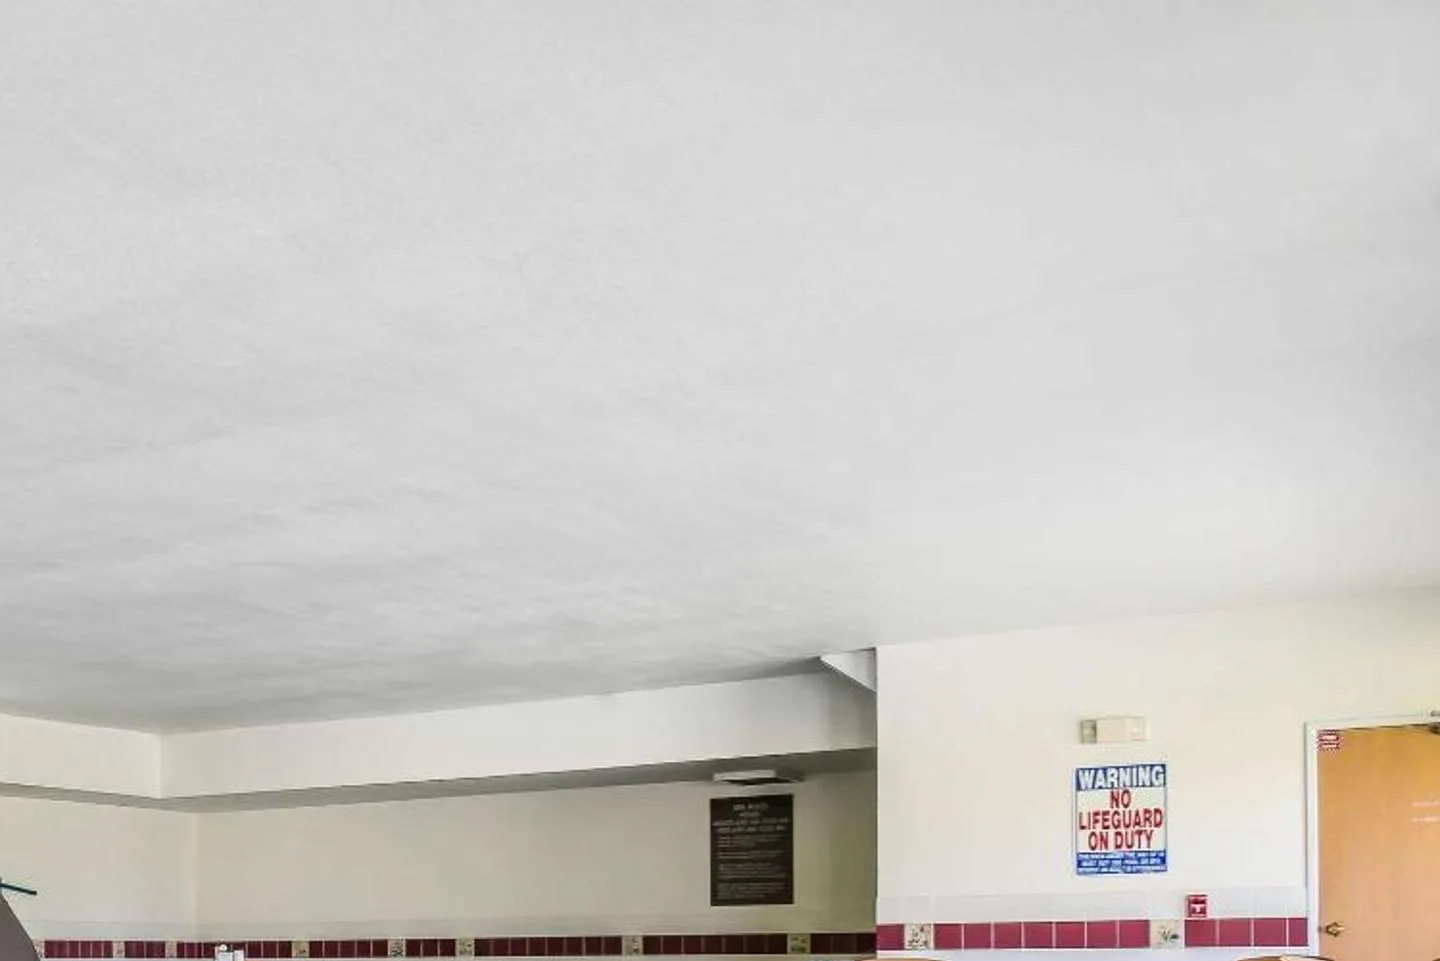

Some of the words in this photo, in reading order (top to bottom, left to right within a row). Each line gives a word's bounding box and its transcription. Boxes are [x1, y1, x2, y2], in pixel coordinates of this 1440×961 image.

[1078, 765, 1165, 790] WARNING
[1109, 789, 1132, 809] NO
[1078, 808, 1165, 831] LIFEGUARD
[1088, 831, 1109, 851] ON
[1114, 829, 1154, 850] DUTY
